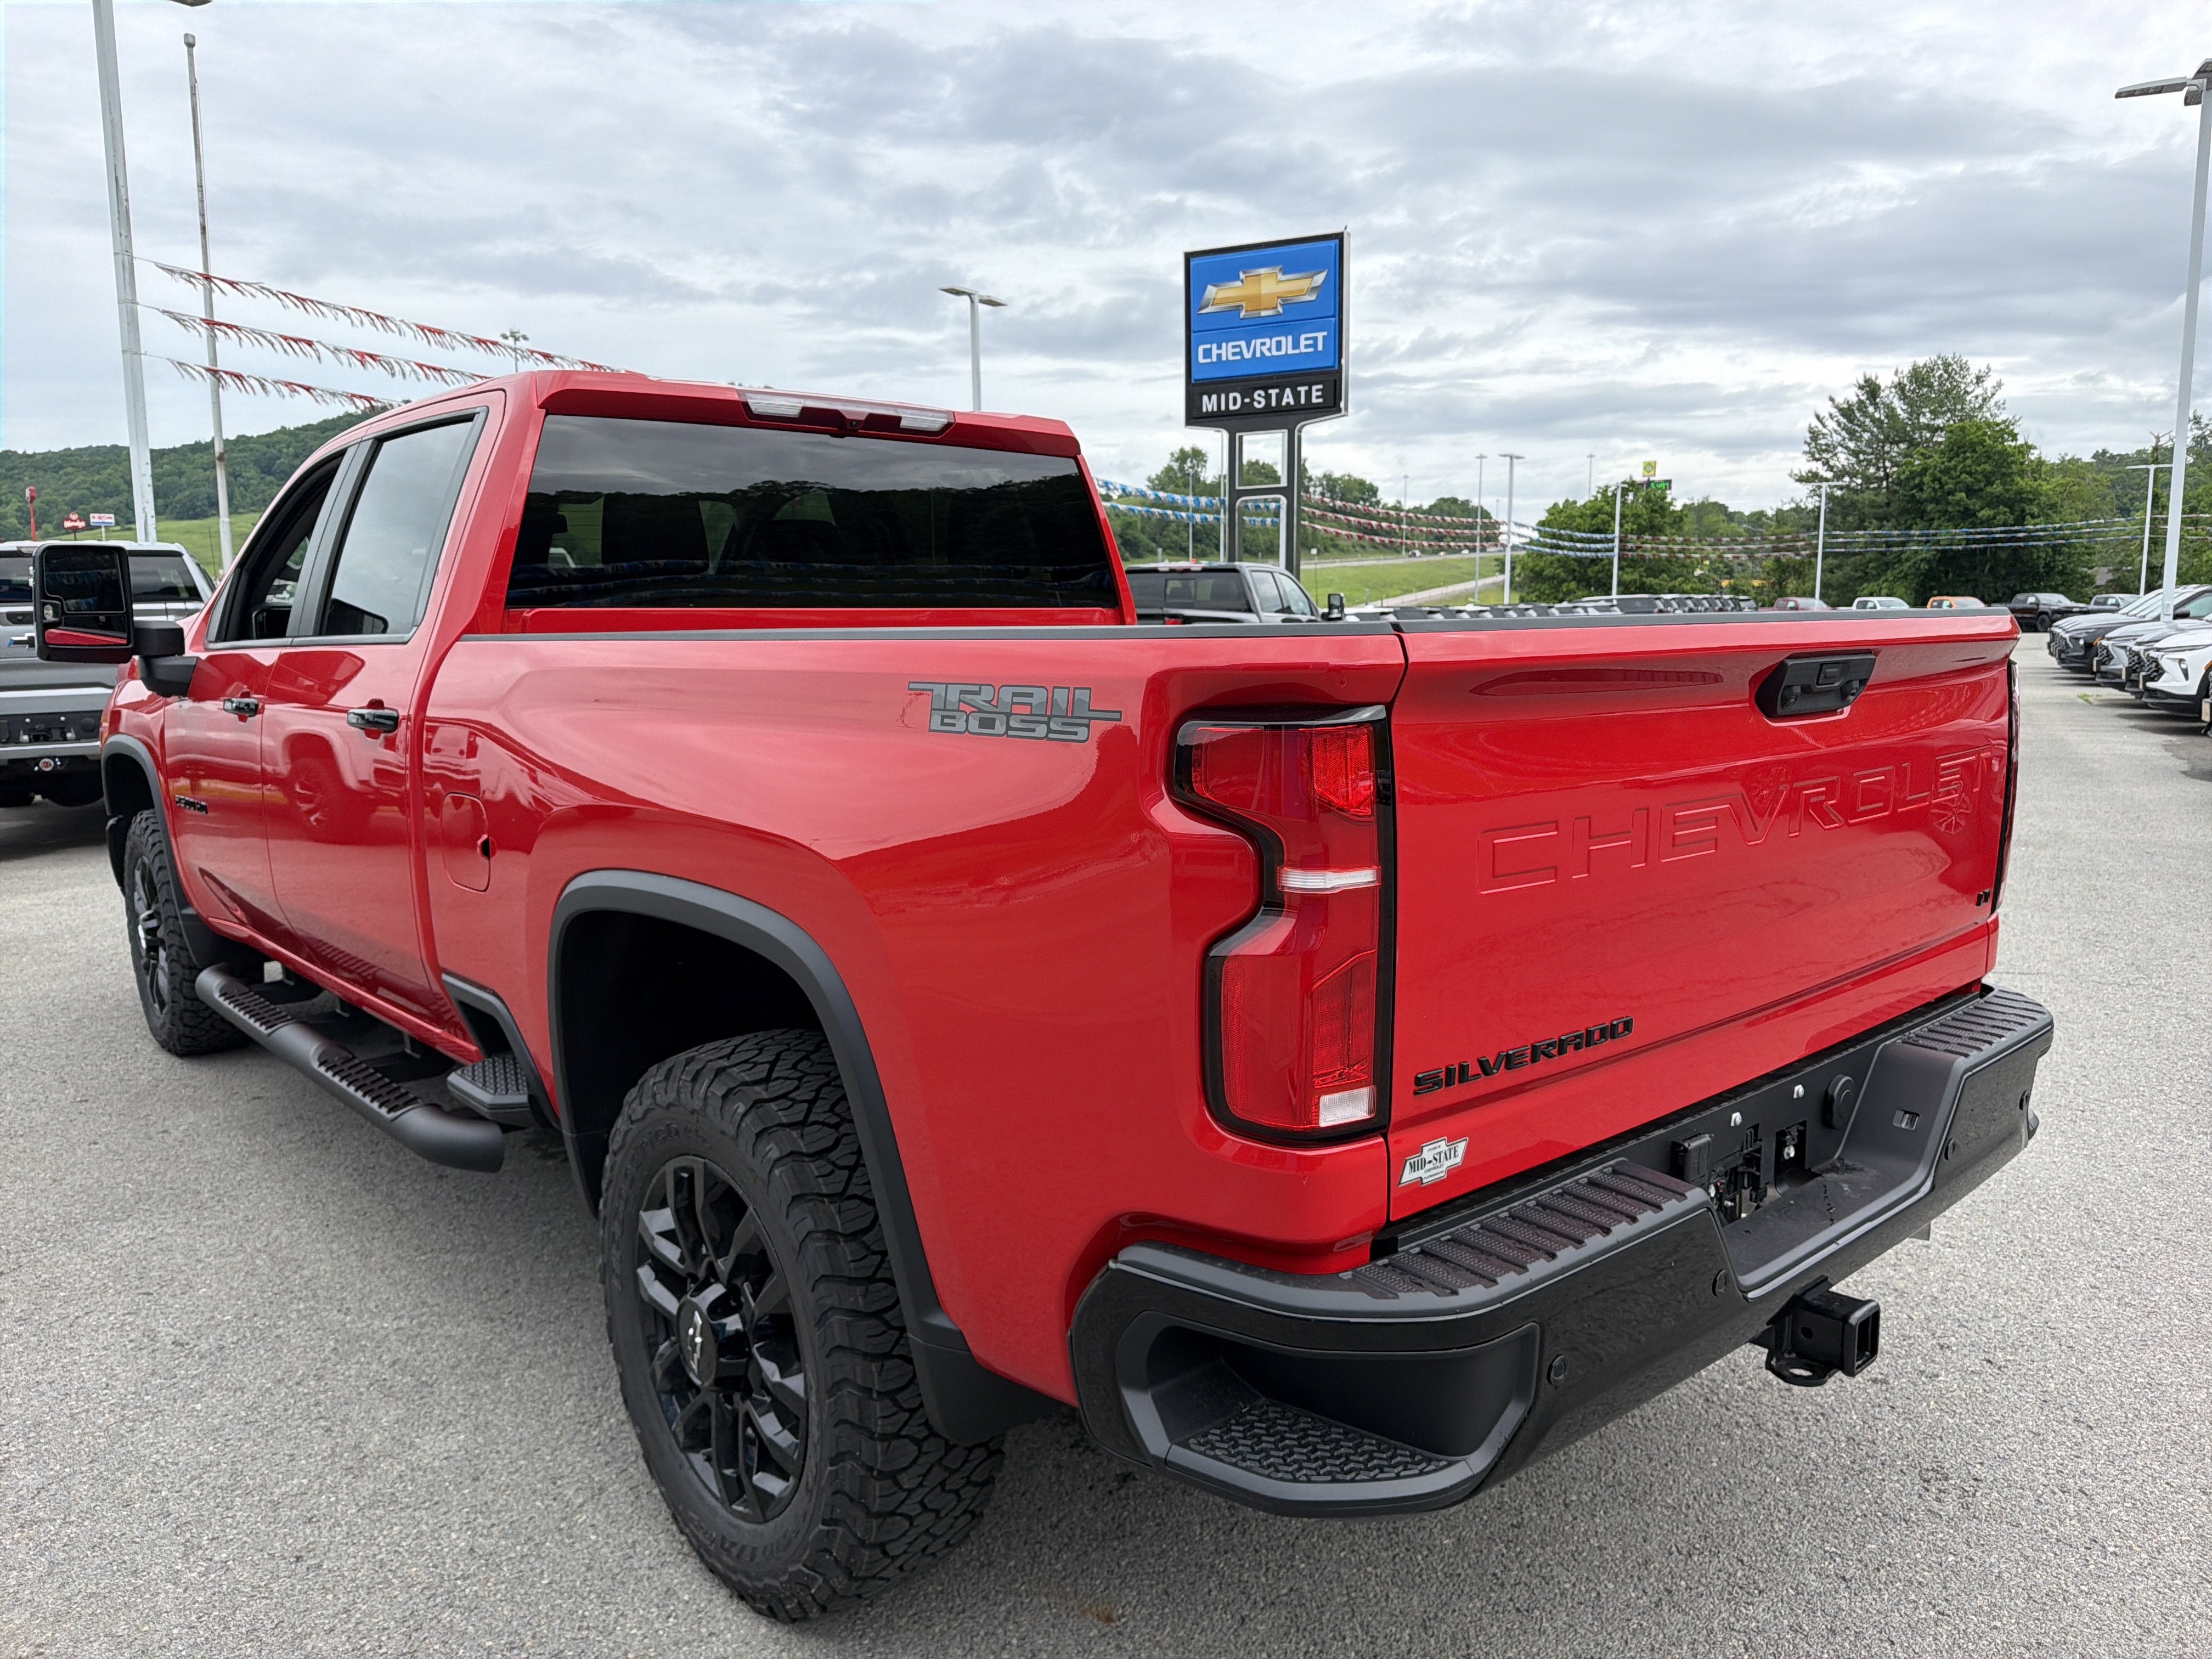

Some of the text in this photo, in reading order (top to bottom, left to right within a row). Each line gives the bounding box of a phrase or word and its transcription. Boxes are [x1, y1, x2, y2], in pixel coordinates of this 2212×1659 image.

[1198, 331, 1328, 363] CHEVROLET
[1201, 384, 1323, 413] MID-STATE
[908, 681, 1122, 722] TRAIL
[928, 709, 1092, 743] BOSS
[1476, 744, 1991, 895] CHEVROLET
[1413, 1015, 1634, 1096] SILVERADO
